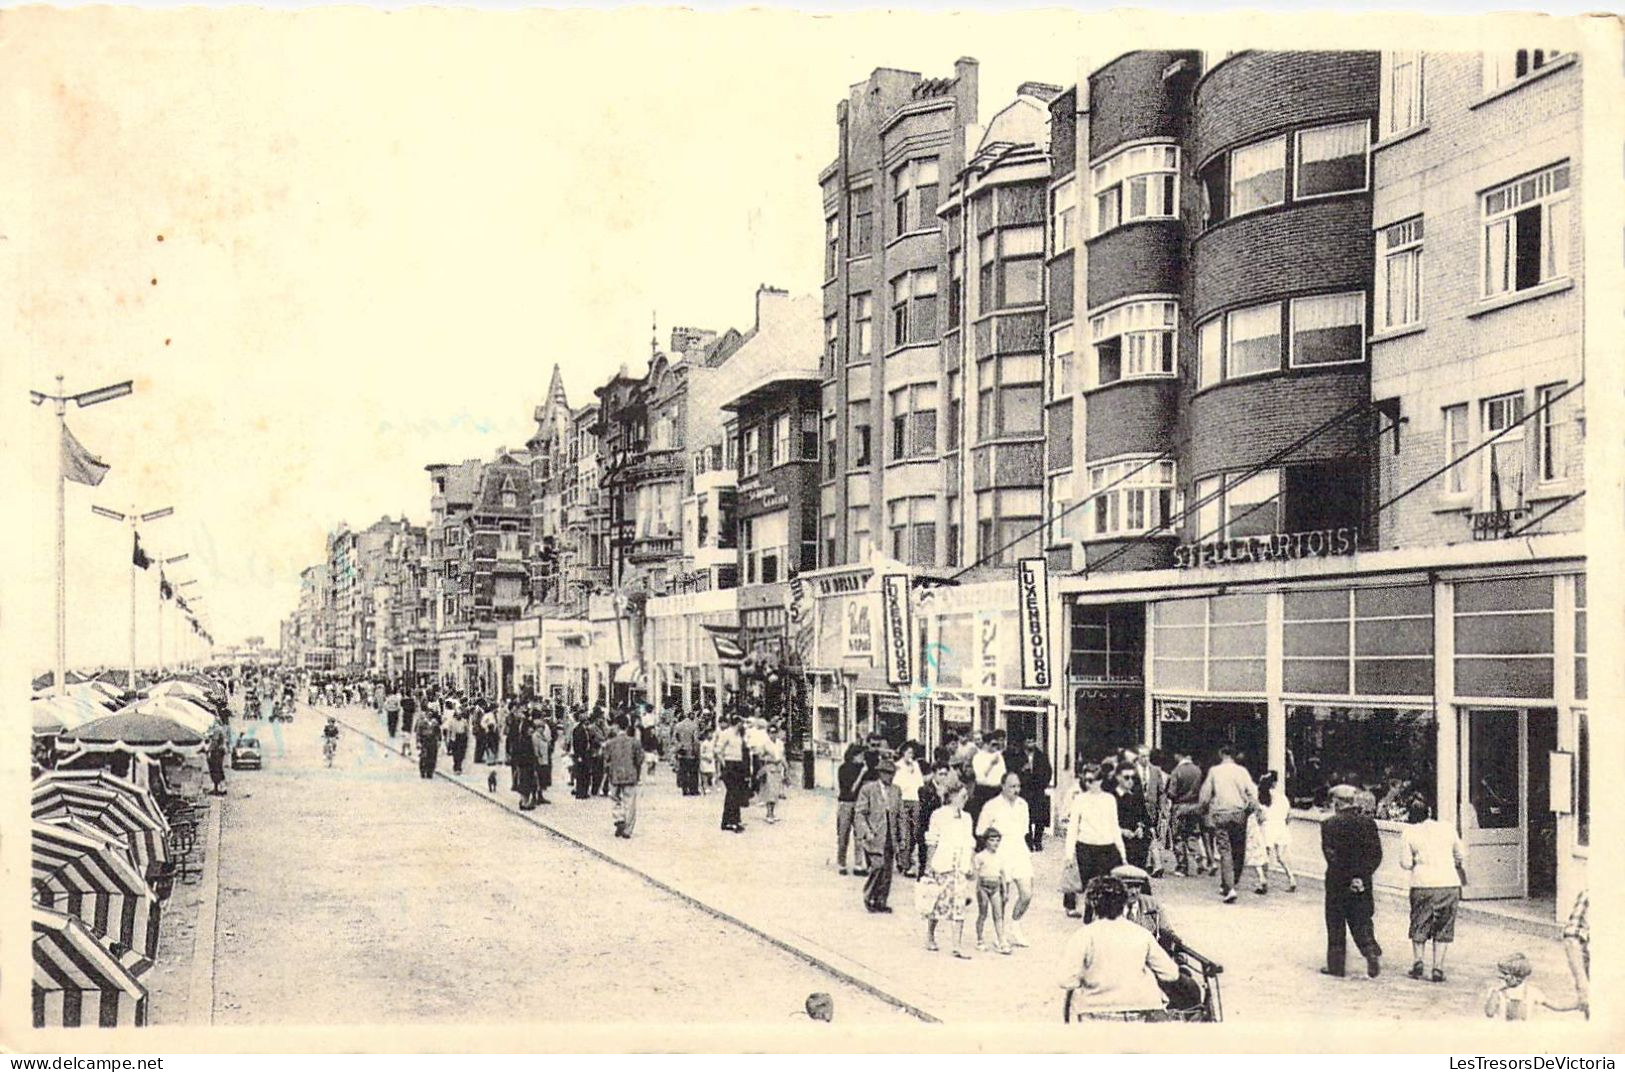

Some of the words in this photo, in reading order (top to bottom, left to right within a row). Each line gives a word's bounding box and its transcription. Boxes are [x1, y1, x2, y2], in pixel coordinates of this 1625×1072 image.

[1173, 536, 1255, 568] STELLA
[1262, 528, 1349, 561] ARTOIS
[886, 578, 909, 681] LUXEMBOURG
[1022, 561, 1046, 685] LUXEMBOURG
